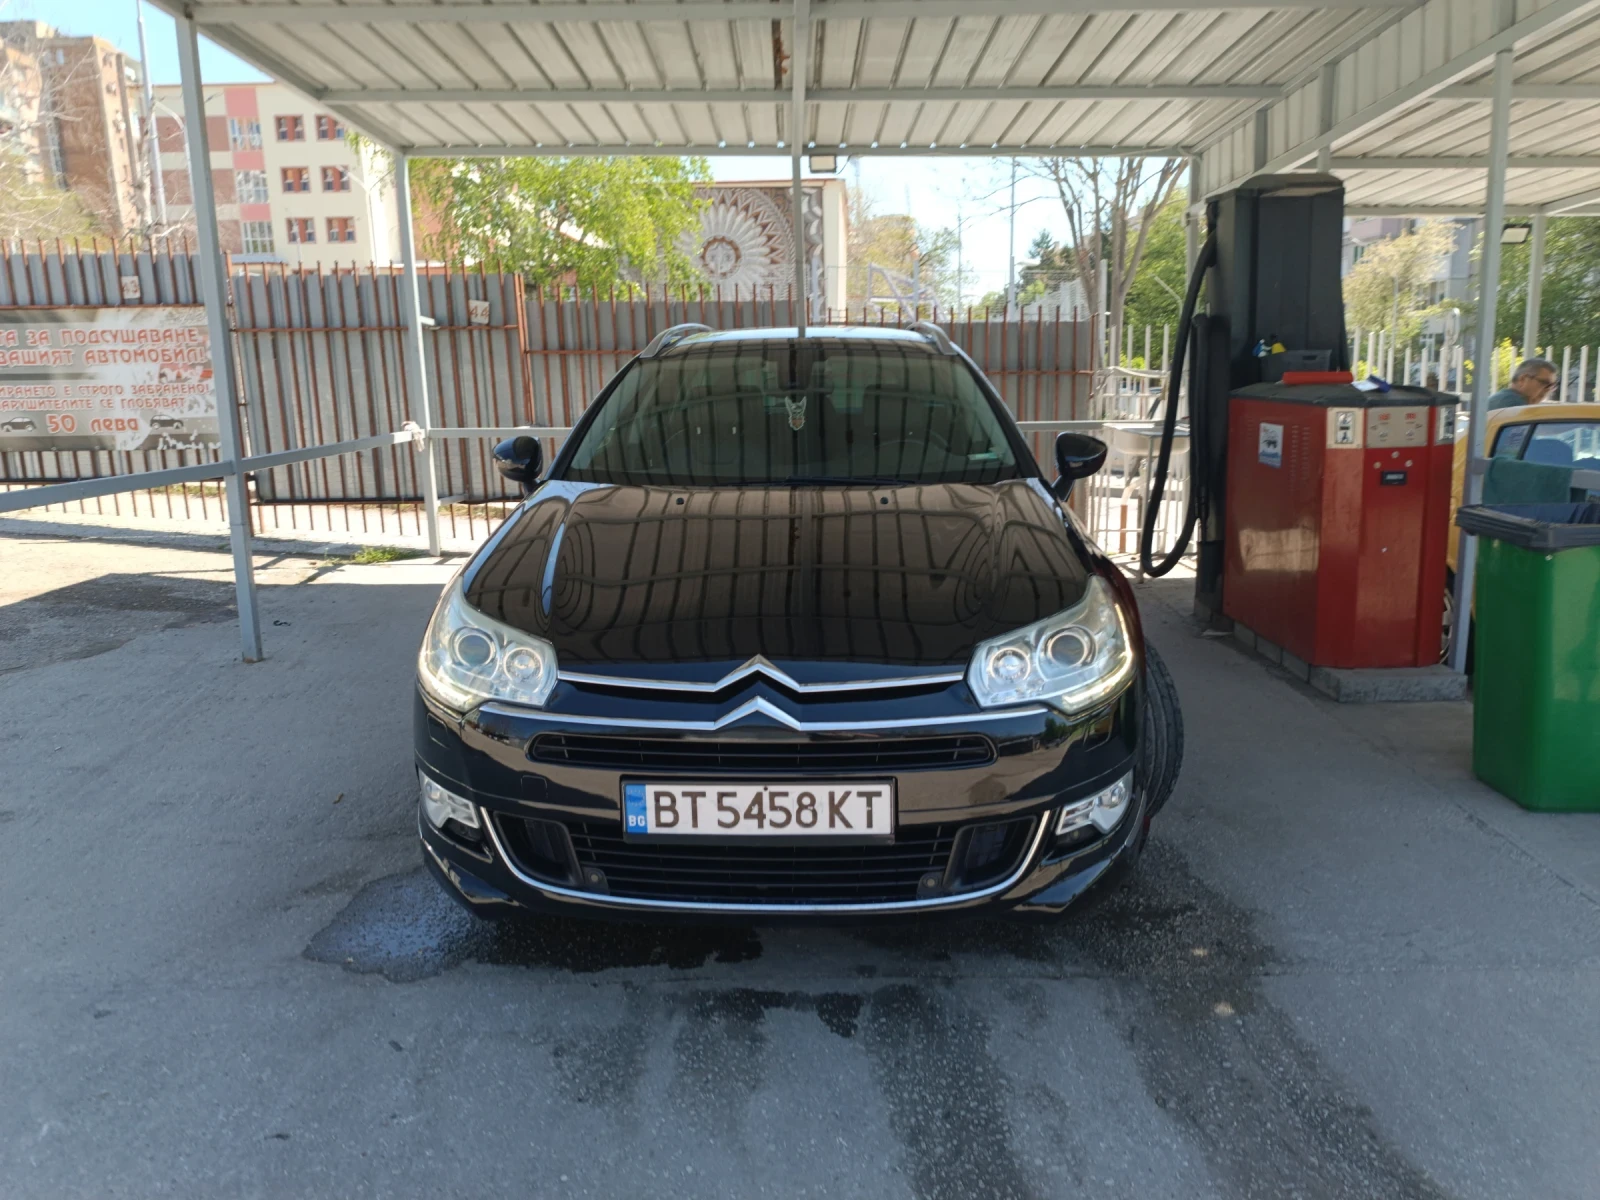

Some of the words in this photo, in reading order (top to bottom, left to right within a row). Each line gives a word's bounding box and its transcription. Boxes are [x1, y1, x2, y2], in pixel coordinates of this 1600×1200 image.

[469, 305, 489, 319] 44
[0, 329, 18, 346] А
[26, 329, 51, 345] ЗА
[61, 328, 199, 345] ПОДСУШАВАНЕ
[84, 347, 206, 365] АВТОМОБИЛ!
[63, 385, 72, 396] Е
[78, 384, 124, 396] СТРОГО
[131, 383, 209, 396] ЗАБРАНЕНО!
[0, 399, 93, 411] АРУШИТЕЛИТЕ
[100, 398, 115, 409] СЕ
[120, 397, 185, 409] ГЛОБЯВАТ
[47, 414, 76, 432] 50
[716, 791, 818, 829] 5458
[628, 815, 646, 827] BG
